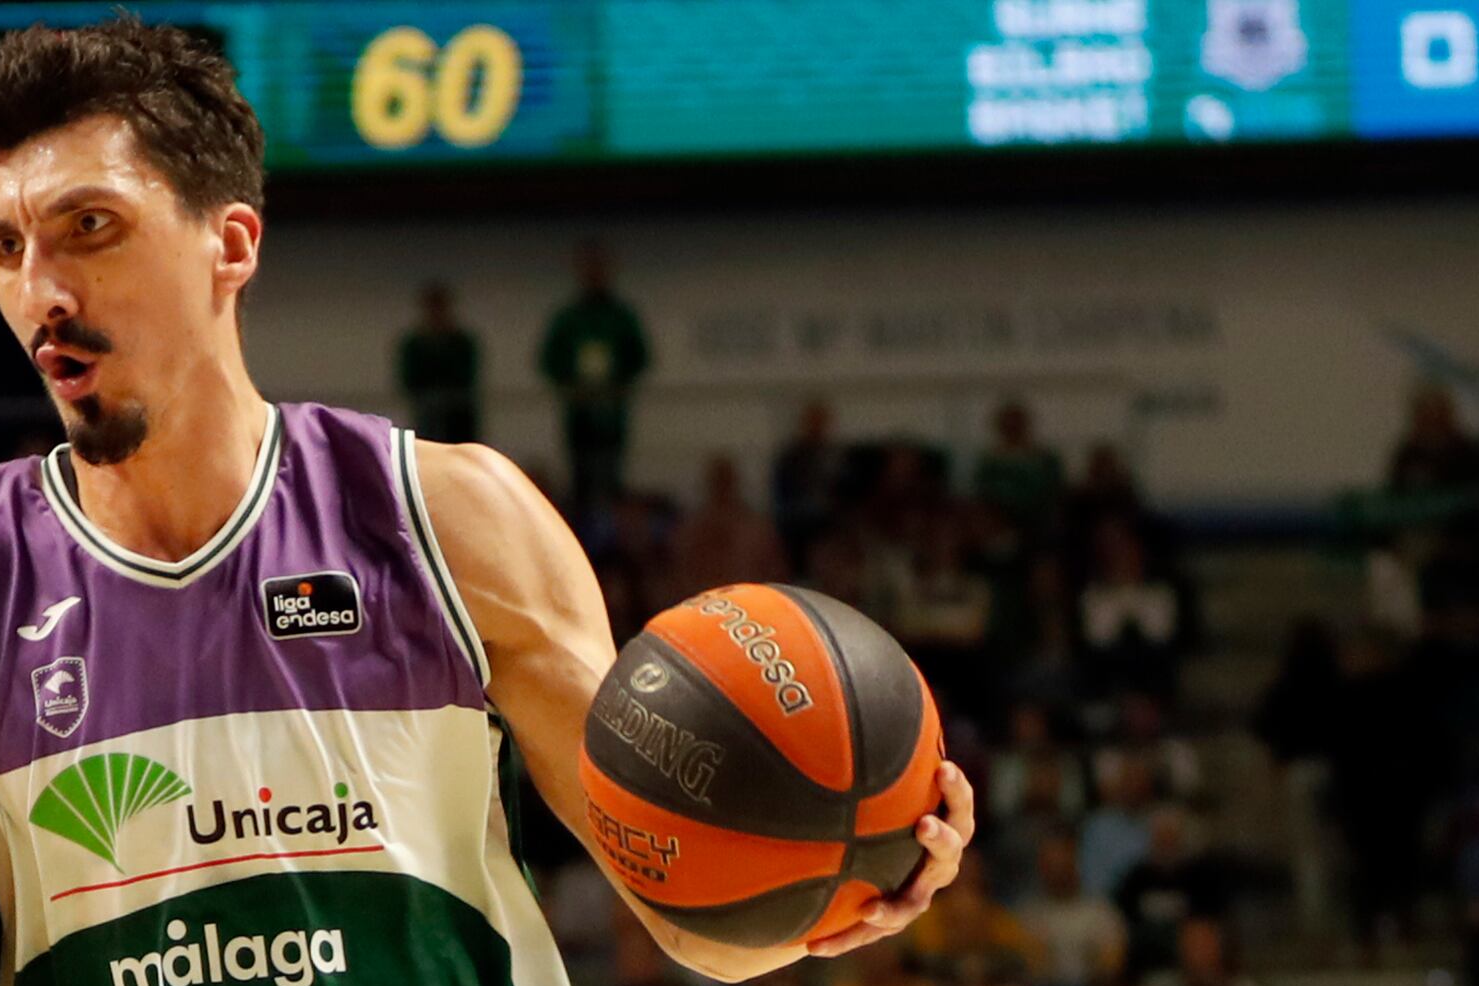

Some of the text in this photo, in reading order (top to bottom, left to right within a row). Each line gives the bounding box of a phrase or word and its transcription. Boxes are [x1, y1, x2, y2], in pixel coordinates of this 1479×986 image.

[351, 23, 523, 150] 60
[273, 593, 310, 614] liga
[276, 608, 354, 630] endesa
[186, 781, 378, 845] Unicaja
